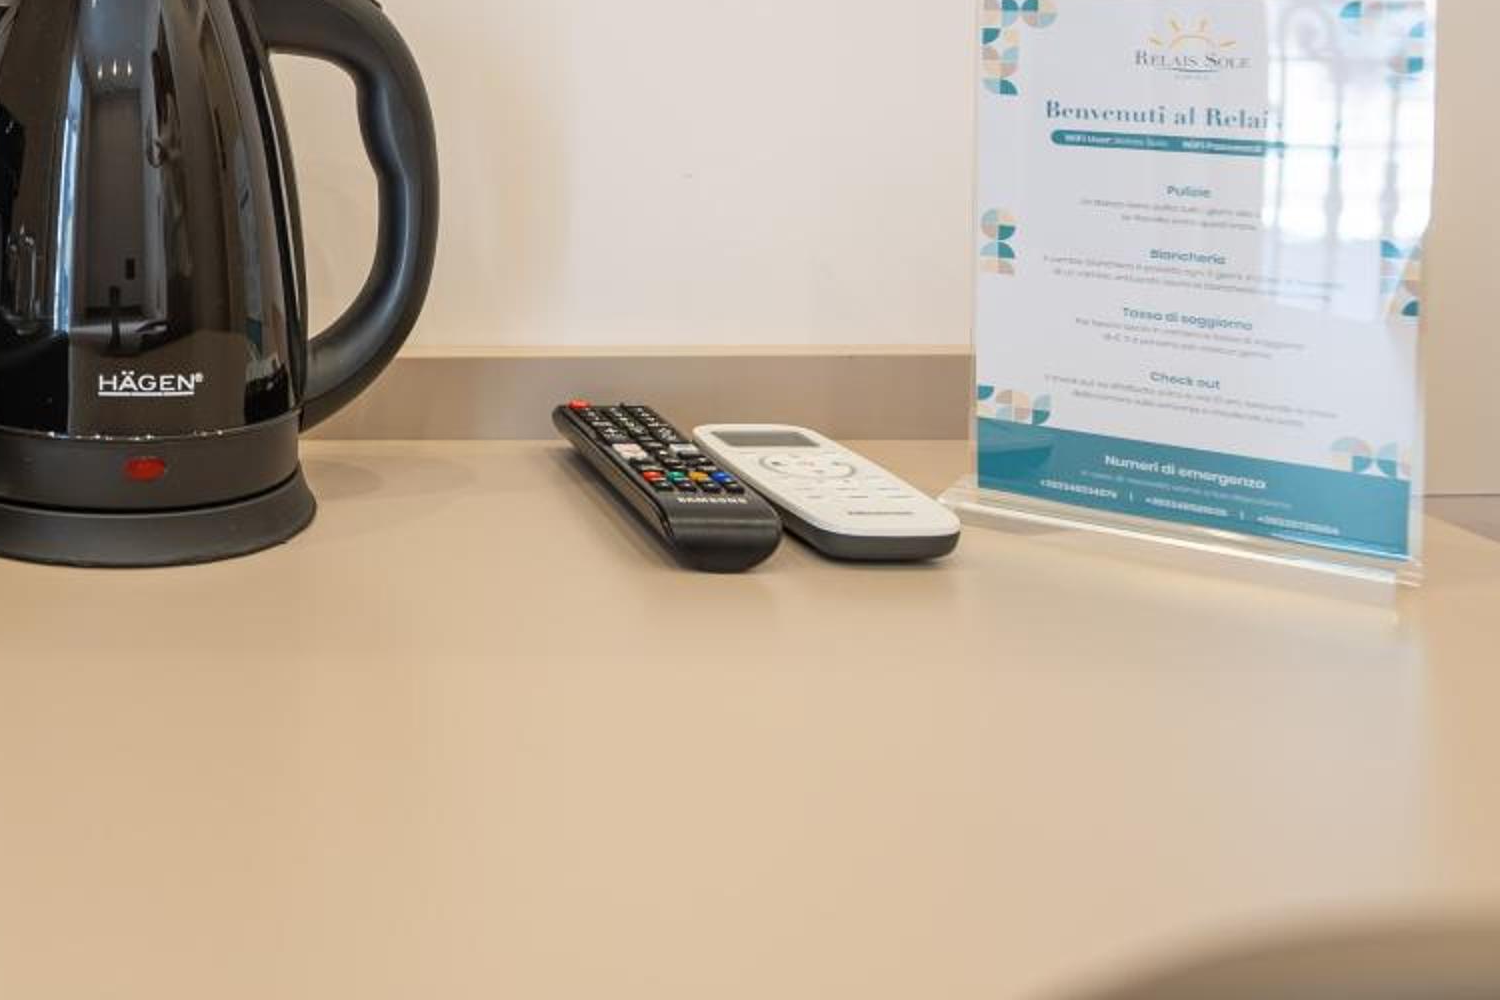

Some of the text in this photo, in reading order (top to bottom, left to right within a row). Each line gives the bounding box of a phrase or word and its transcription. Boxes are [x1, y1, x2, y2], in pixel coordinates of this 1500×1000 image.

[1046, 98, 1283, 130] Benvenuti al Relai
[1149, 248, 1227, 265] Biancheria
[1181, 314, 1253, 331] soggiorno
[98, 370, 195, 391] HÄGEN
[1149, 370, 1194, 386] Check
[1196, 376, 1221, 390] out
[1104, 454, 1159, 472] Numeri
[1161, 463, 1176, 475] di
[1177, 467, 1267, 489] emergenza
